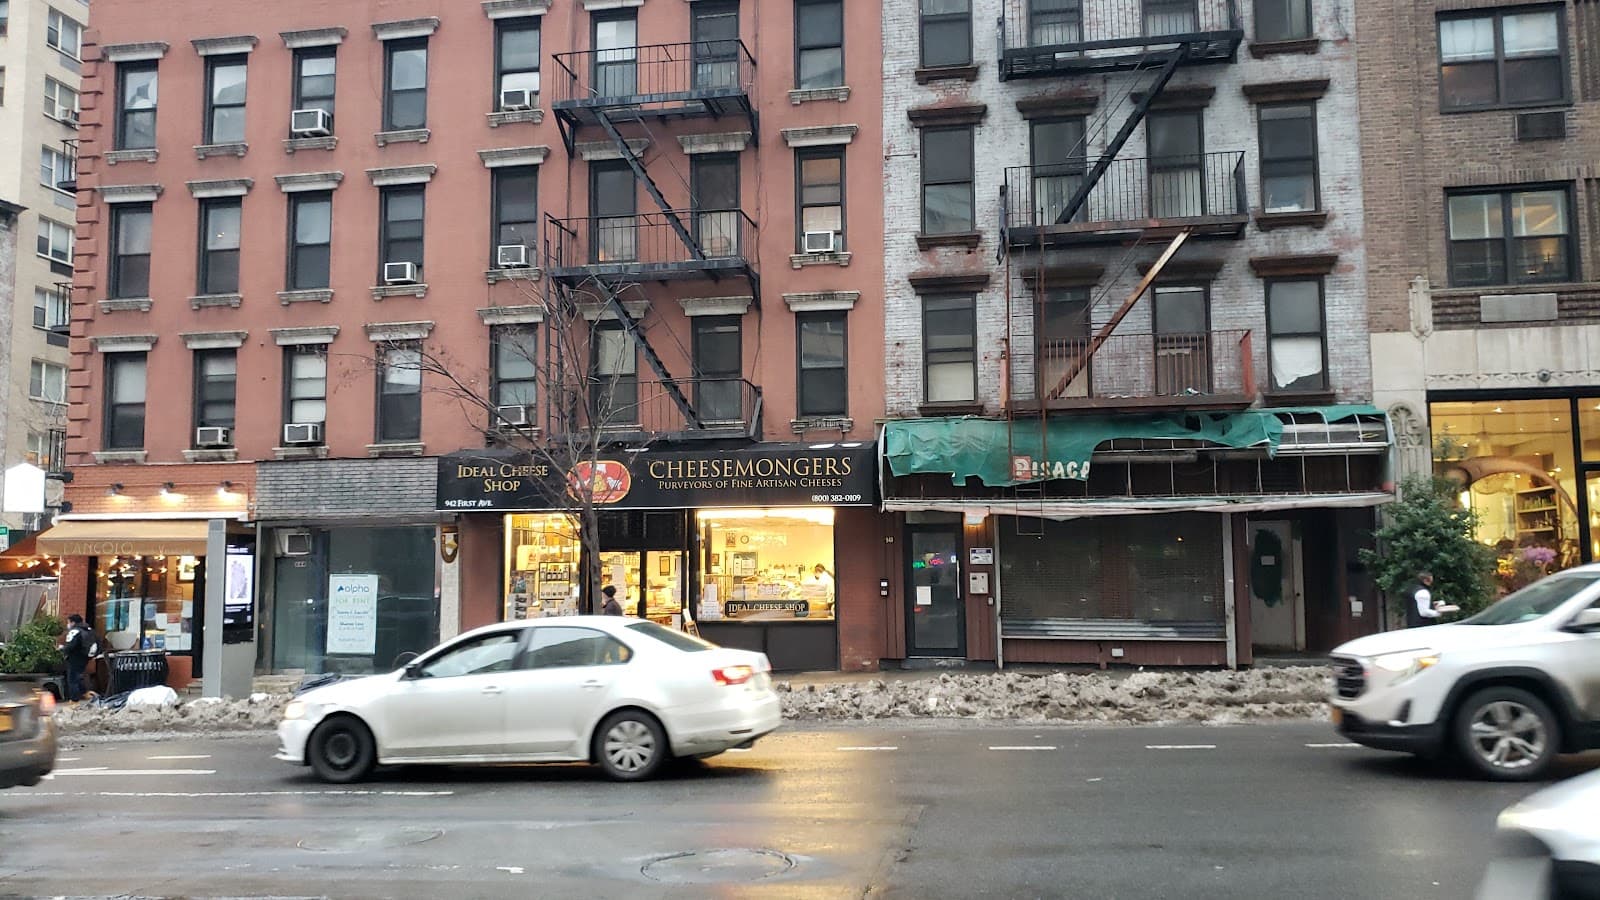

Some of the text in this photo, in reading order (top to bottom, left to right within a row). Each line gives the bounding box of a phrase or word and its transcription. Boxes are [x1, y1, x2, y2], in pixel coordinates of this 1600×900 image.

[457, 463, 549, 478] IDEAL CHEESE
[649, 456, 852, 479] CHEESEMONGERS
[484, 479, 521, 493] SHOP
[658, 477, 842, 490] PURVEYORS OF FINE ARTISAN CHEESES
[457, 499, 477, 508] FIRST
[811, 494, 861, 502] (800) 382-0109
[344, 584, 370, 594] alpha
[728, 602, 806, 612] IDEAL CHEESE SHOP
